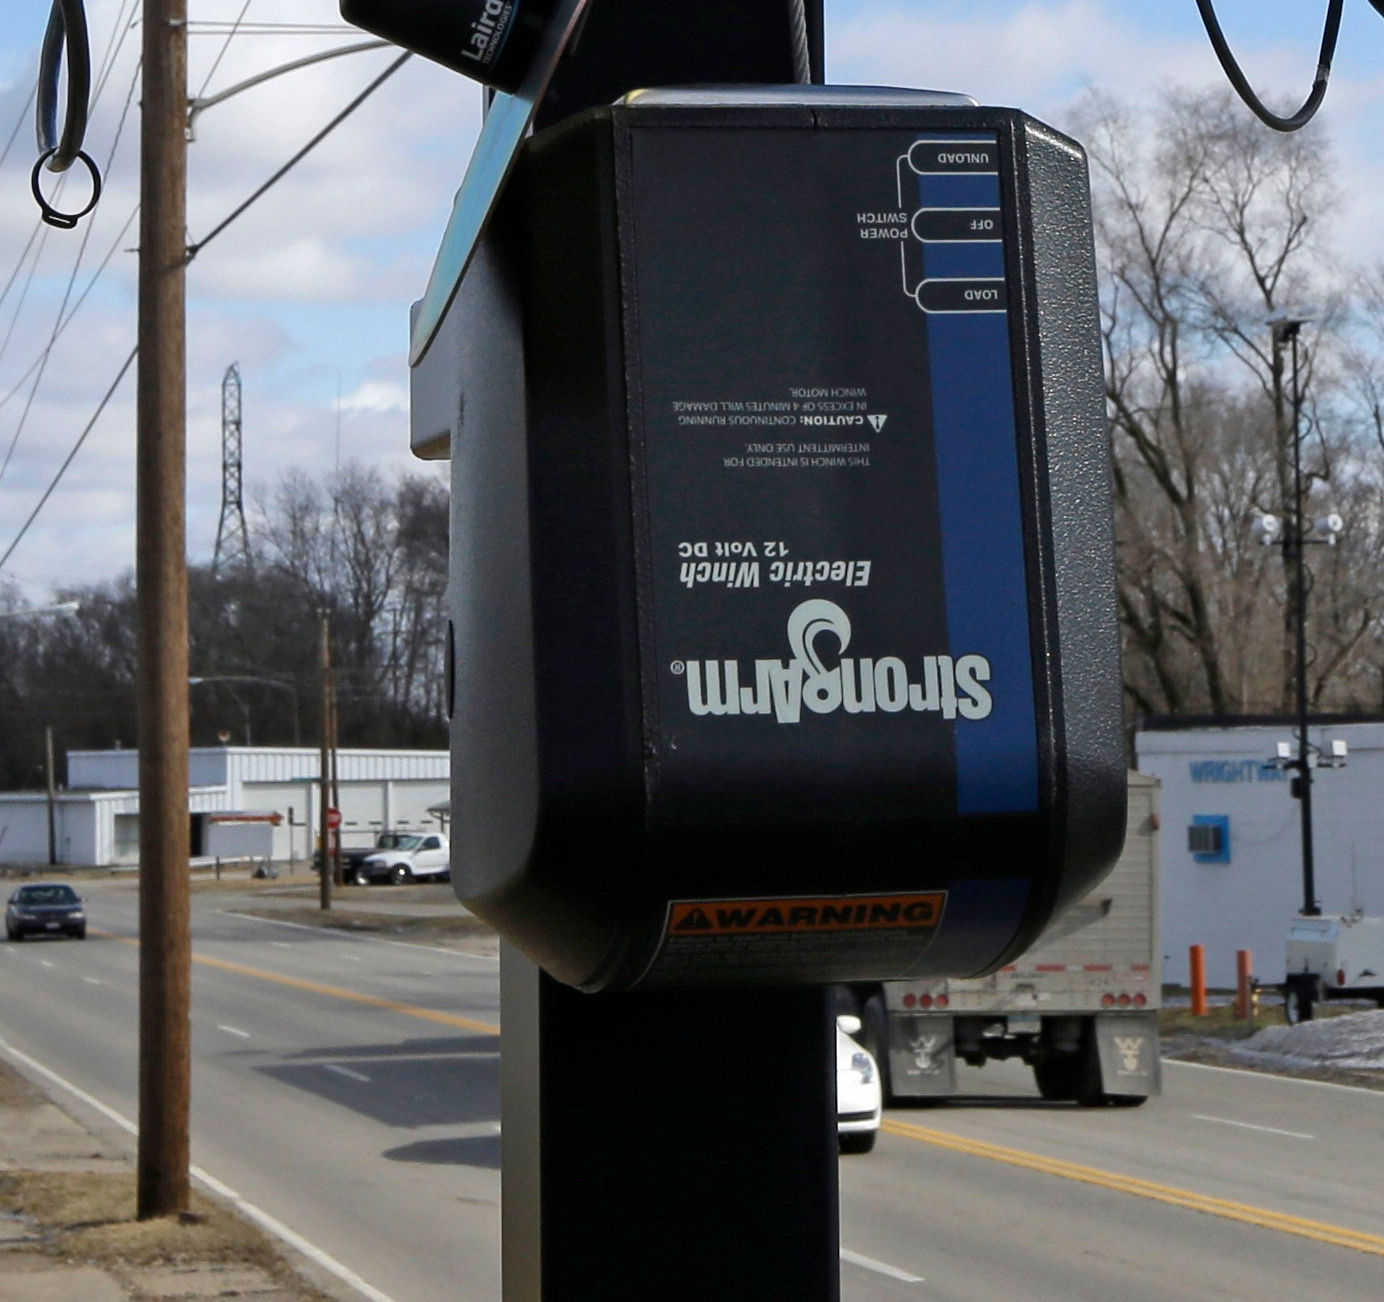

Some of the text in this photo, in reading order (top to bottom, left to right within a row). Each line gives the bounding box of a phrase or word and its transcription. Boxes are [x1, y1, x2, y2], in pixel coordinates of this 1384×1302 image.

[937, 153, 989, 164] UNLOAD
[856, 212, 908, 224] SWITCH
[970, 219, 994, 230] OFF
[859, 227, 908, 239] POWER
[963, 289, 998, 301] LOAD
[789, 387, 867, 397] WINCH MOTOR.
[671, 401, 868, 411] IN EXCESS OF 4 MINUTES WILL DAMAGE
[677, 414, 864, 426] CAUTION: CONTINUOUS RUNNING
[744, 442, 871, 453] INTERMITTENT USE ONLY.
[723, 456, 871, 467] THIS WINCH IS INTENDED FOR
[677, 541, 790, 558] 12 Volt DC
[679, 560, 872, 588] Electric Winch
[716, 901, 933, 928] WARNING
